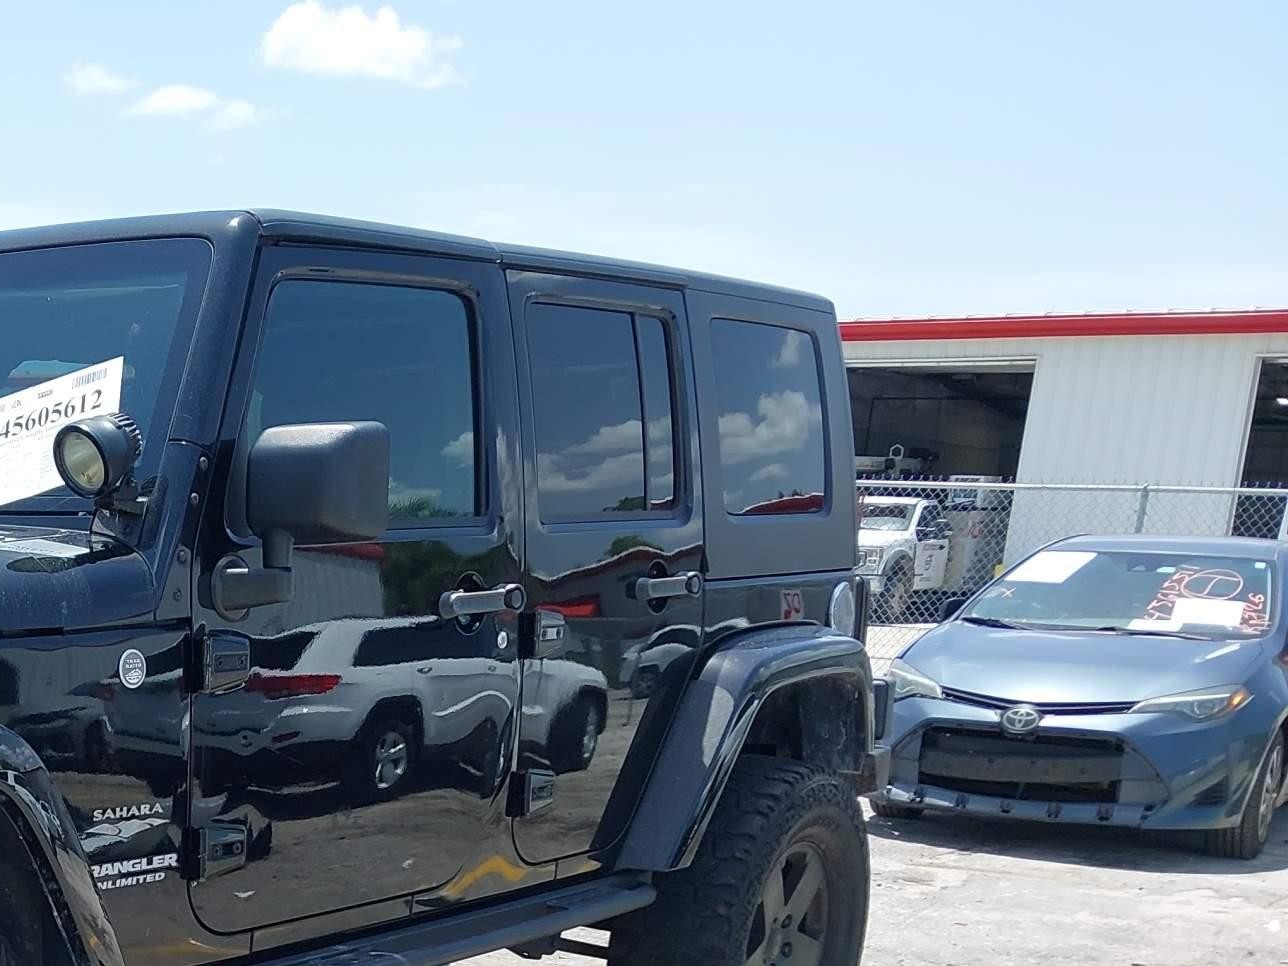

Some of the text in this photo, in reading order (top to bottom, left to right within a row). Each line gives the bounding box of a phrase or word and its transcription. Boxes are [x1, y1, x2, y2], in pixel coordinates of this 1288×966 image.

[0, 388, 103, 439] 45605612
[92, 802, 164, 822] SAHARA
[90, 853, 179, 878] RANGLER
[97, 872, 166, 891] NLIMITED
